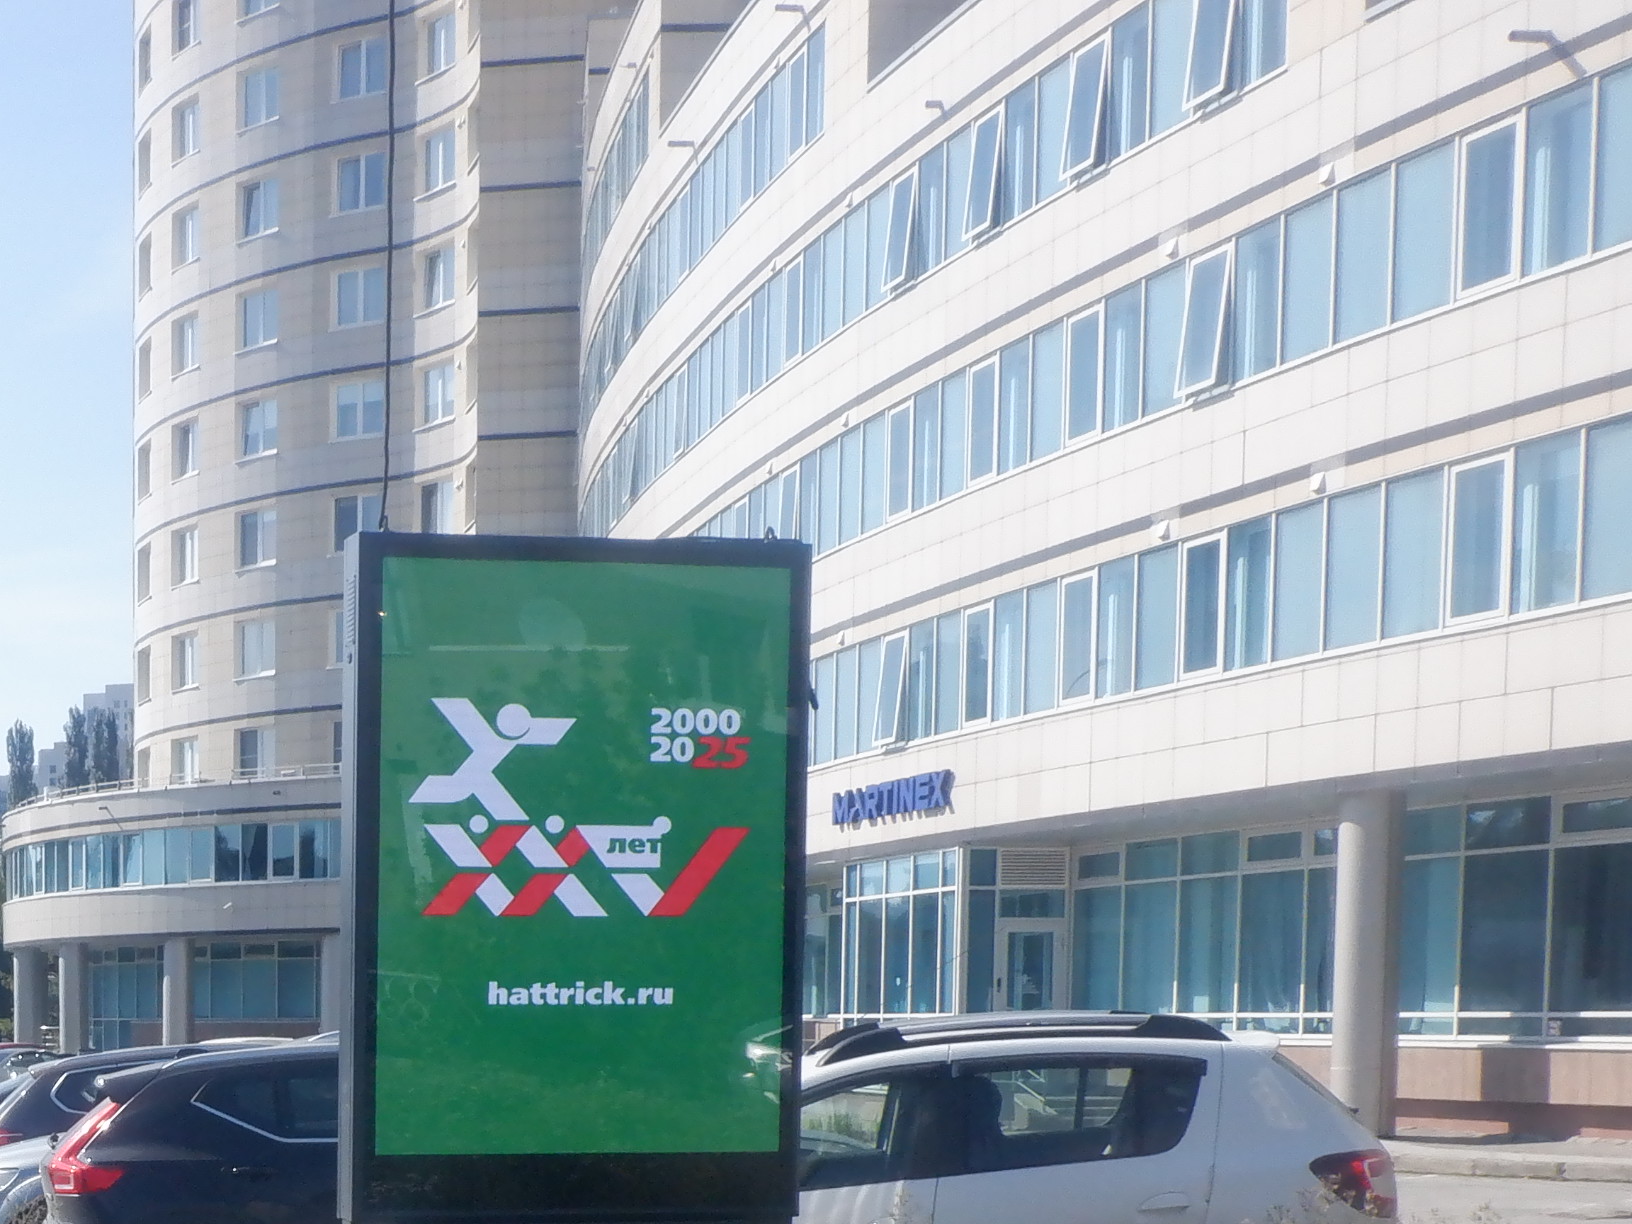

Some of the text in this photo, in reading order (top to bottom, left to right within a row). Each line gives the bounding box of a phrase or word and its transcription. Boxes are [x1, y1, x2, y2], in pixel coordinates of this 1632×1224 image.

[650, 707, 741, 735] 2000
[650, 736, 752, 769] 2025
[832, 769, 955, 826] MARTINEX
[606, 836, 662, 855] лет
[487, 980, 674, 1006] hattrick.ru
